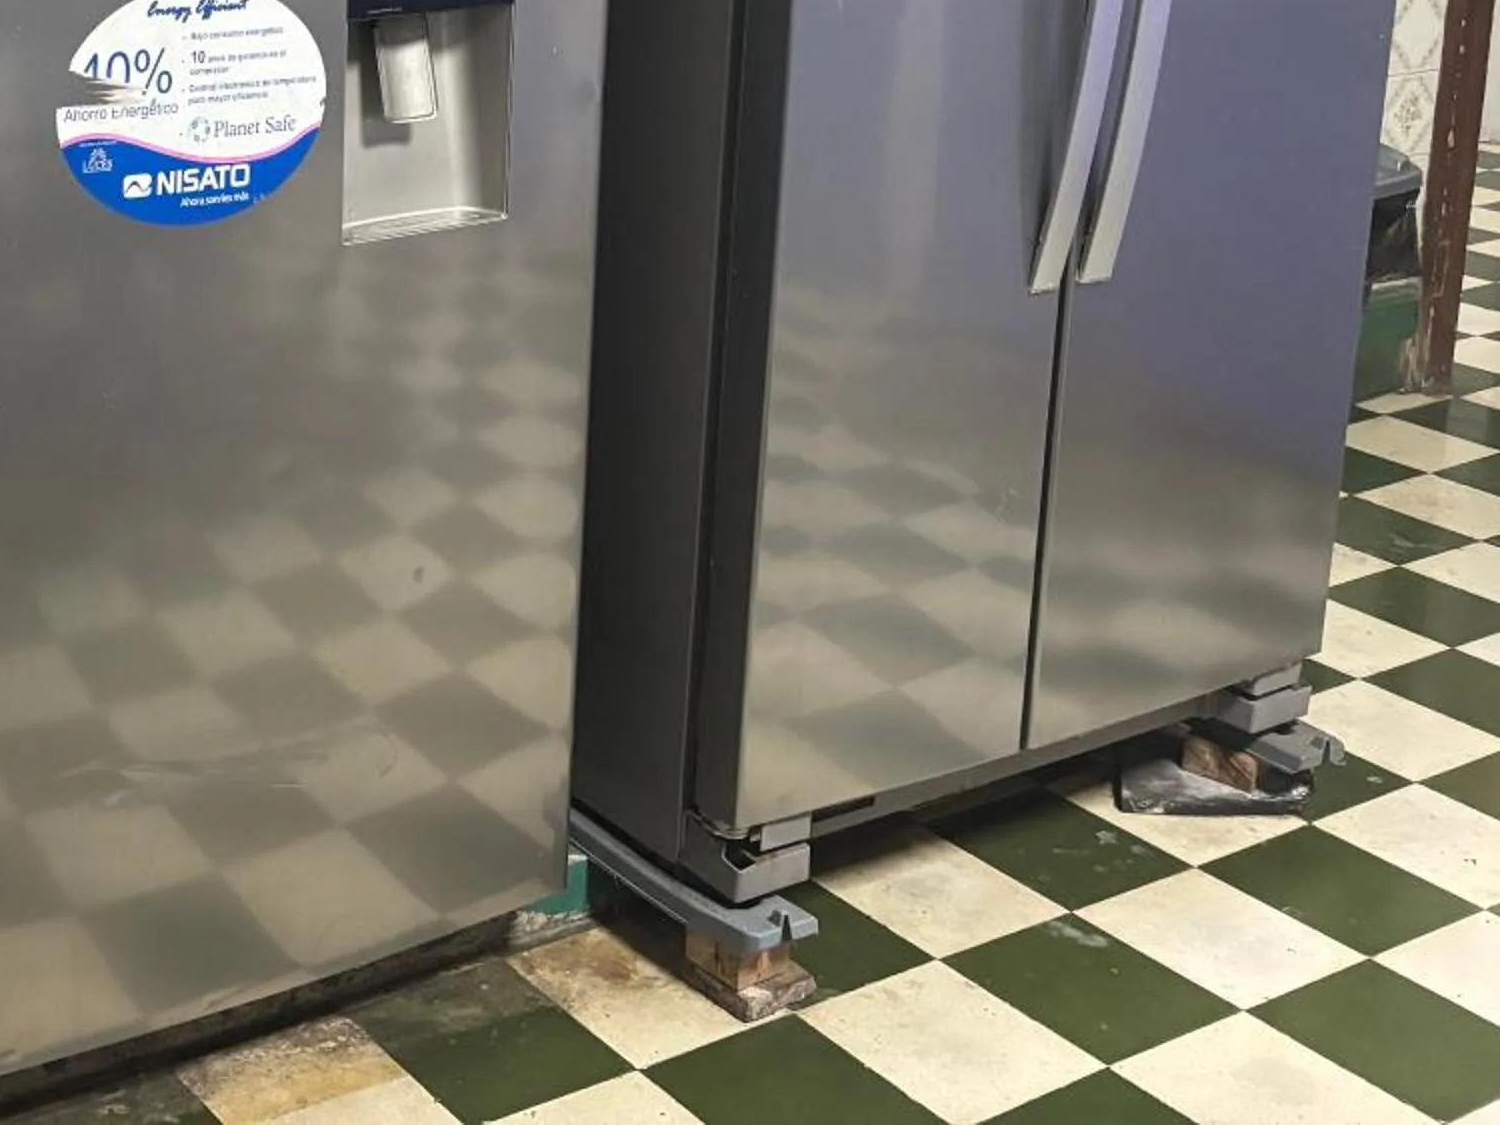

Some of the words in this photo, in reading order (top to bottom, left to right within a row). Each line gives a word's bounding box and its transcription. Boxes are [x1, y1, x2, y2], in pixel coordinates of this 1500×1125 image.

[191, 50, 206, 64] 10
[64, 106, 107, 123] Ahorro
[214, 119, 260, 139] Planet
[265, 114, 297, 134] Safe
[156, 164, 250, 196] NISATO
